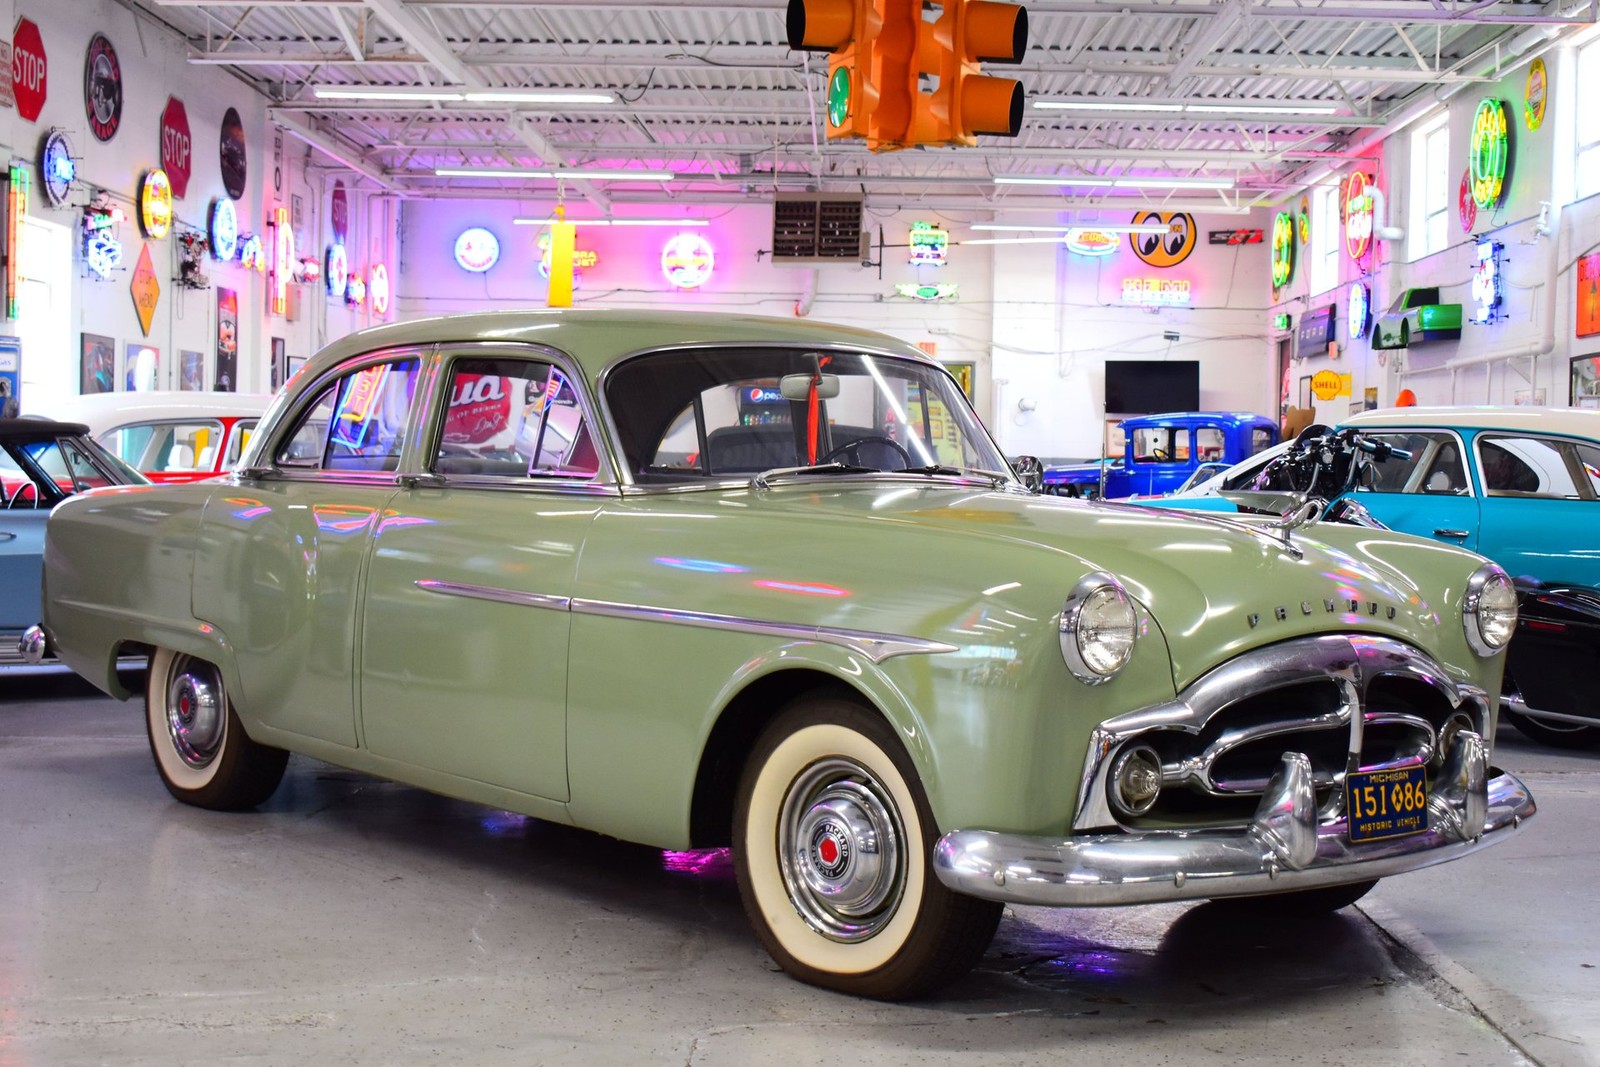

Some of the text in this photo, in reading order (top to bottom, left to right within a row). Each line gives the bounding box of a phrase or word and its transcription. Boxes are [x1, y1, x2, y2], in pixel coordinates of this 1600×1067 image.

[13, 46, 45, 93] STOP
[164, 125, 190, 170] STOP
[1301, 325, 1324, 339] FORD
[1314, 381, 1337, 389] SHELL
[1249, 598, 1396, 628] PACKARD
[1369, 771, 1409, 783] MICHIGAN
[1360, 816, 1420, 831] HISTORIC VEHICLE
[825, 824, 849, 857] PACKARD
